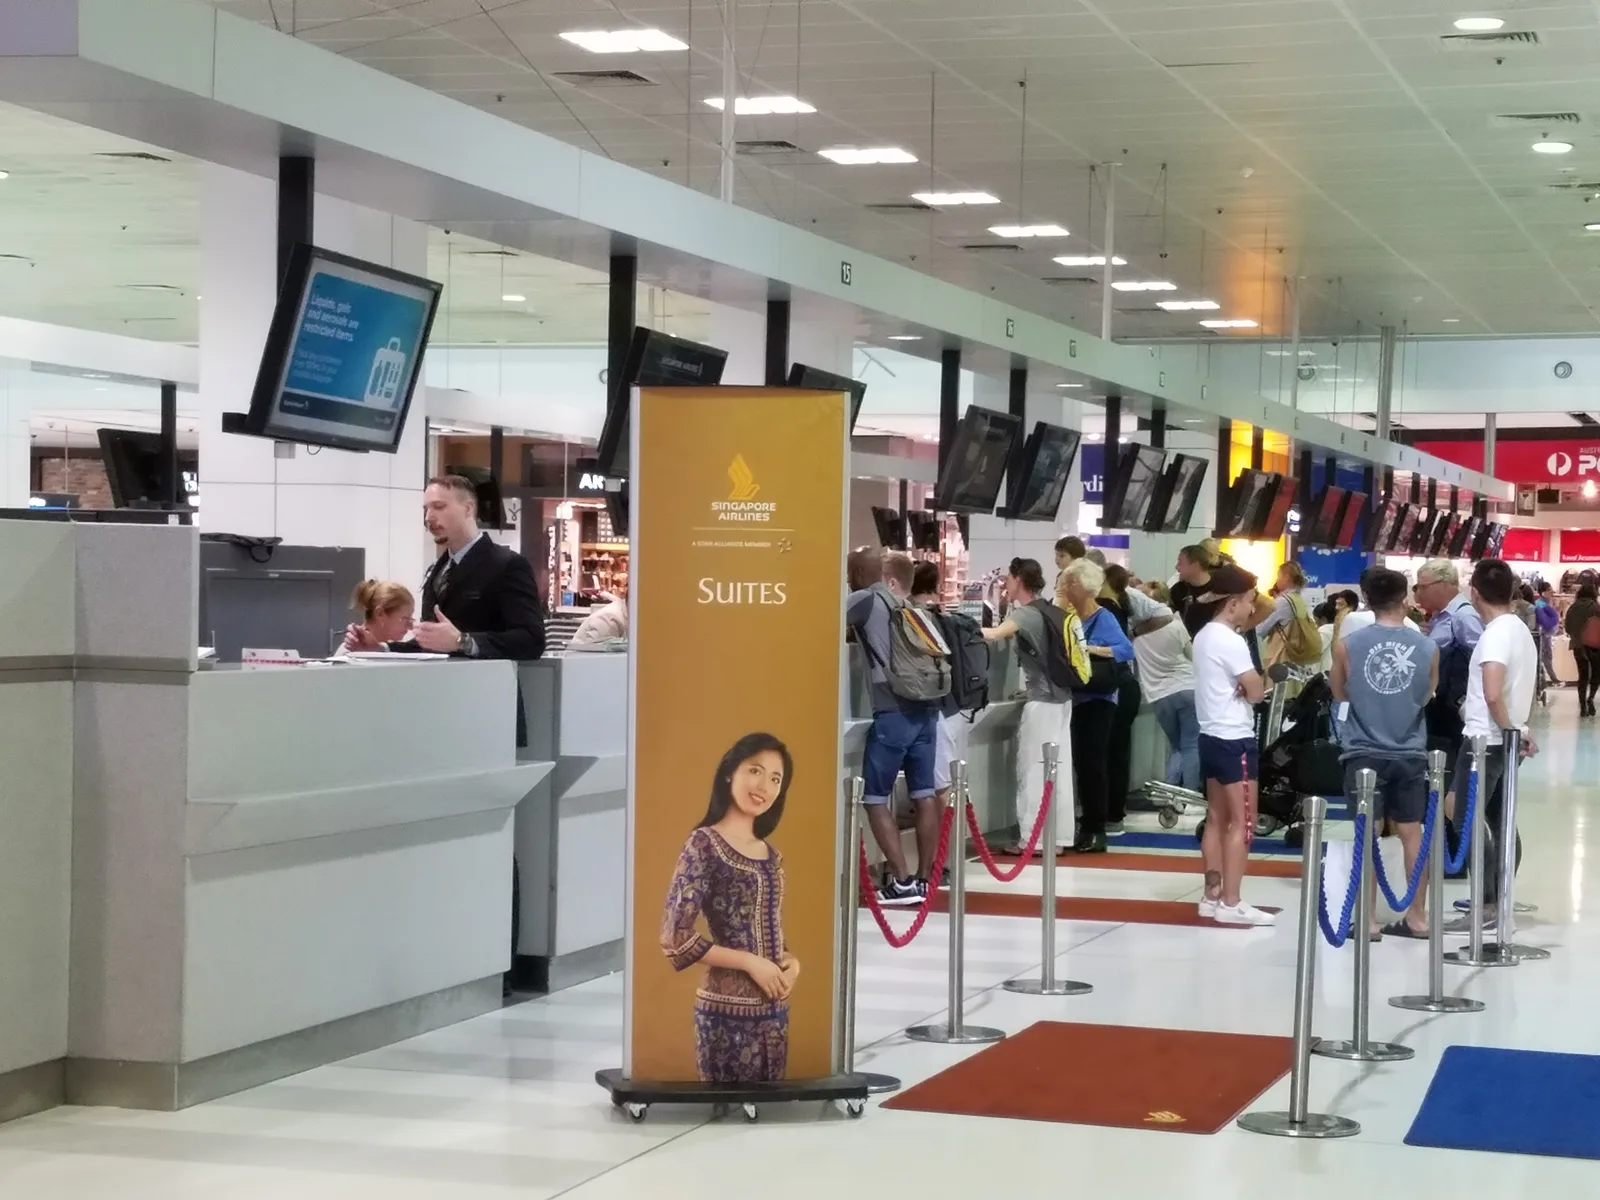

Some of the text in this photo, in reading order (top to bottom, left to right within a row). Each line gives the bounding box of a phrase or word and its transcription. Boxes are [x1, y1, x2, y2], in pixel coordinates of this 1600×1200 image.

[842, 263, 851, 283] 15
[1578, 454, 1600, 475] P
[711, 501, 777, 512] SINGAPORE
[718, 512, 771, 522] AIRLINES
[697, 540, 714, 548] STAR
[744, 541, 772, 549] MEMBER
[697, 577, 787, 605] SUITES
[1368, 642, 1383, 655] DIE
